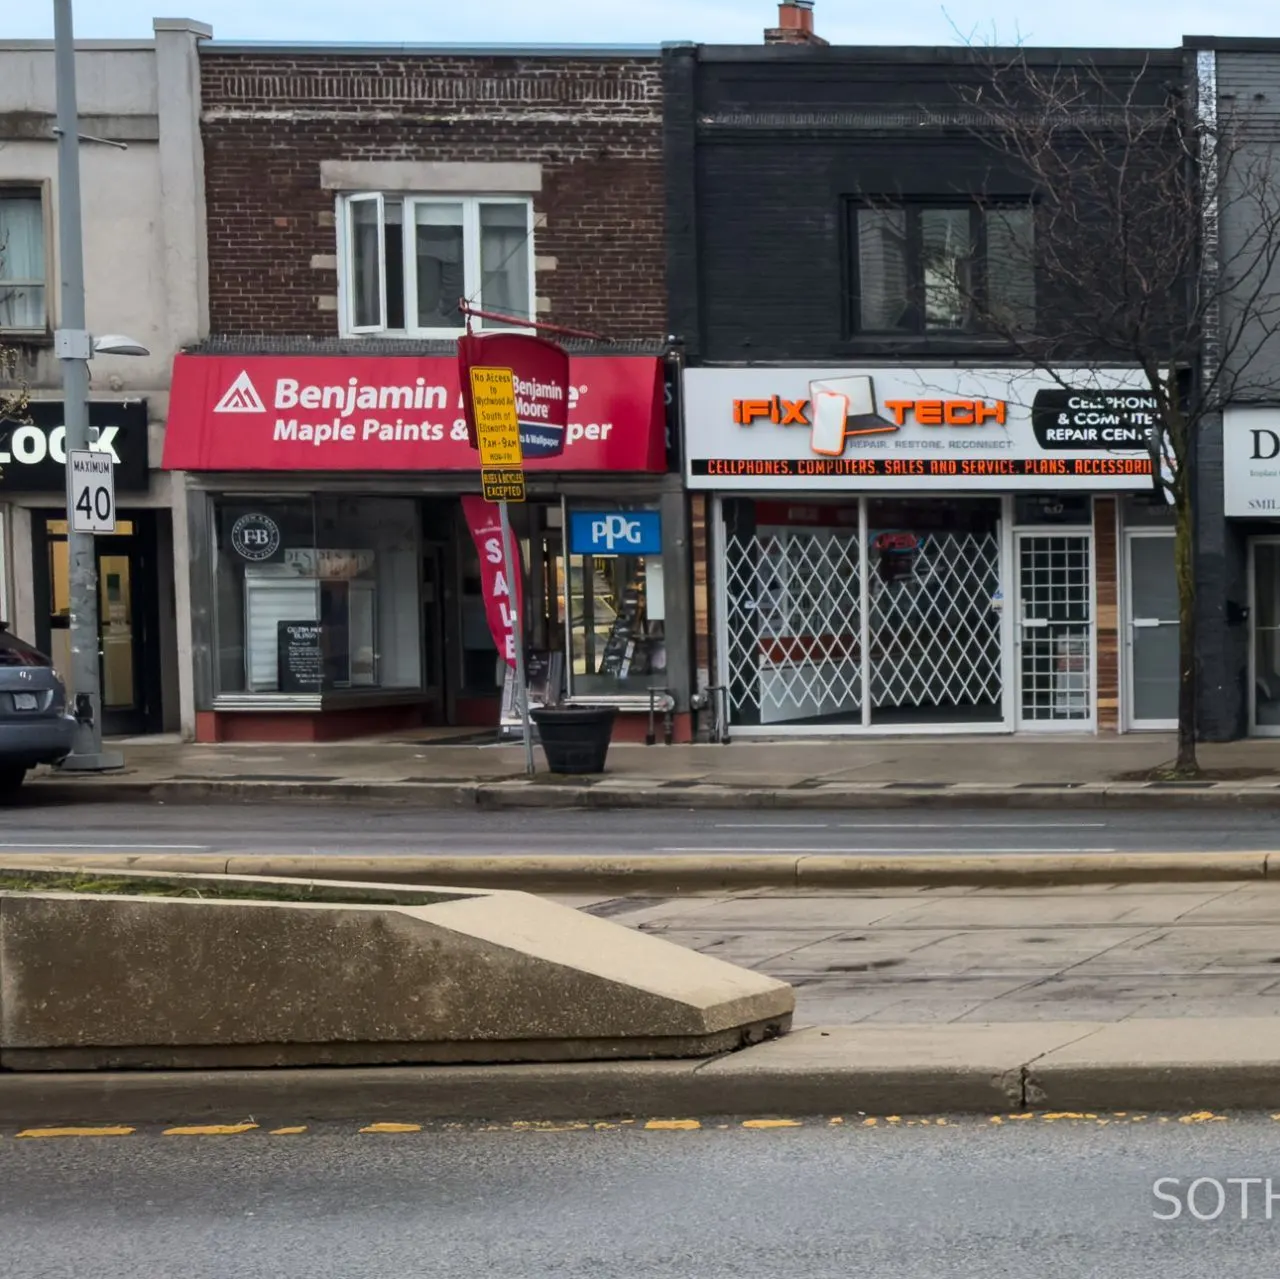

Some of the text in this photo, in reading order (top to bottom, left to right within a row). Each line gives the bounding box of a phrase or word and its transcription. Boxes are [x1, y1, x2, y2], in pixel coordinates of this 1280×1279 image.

[474, 373, 511, 382] No Access
[490, 386, 498, 394] to
[512, 375, 563, 401] Benjamin
[274, 377, 448, 417] Benjamin
[1068, 397, 1158, 410] CELLPHON
[515, 396, 549, 418] Moore
[884, 400, 1007, 425] TECH
[482, 411, 501, 420] South
[1057, 412, 1070, 425] &
[273, 419, 468, 446] Maple Paints &
[1046, 428, 1098, 440] REPAIR
[74, 460, 110, 473] MAXIMUM
[707, 459, 793, 475] CELLPHONES.
[798, 459, 879, 475] COMPUTERS.
[884, 459, 924, 475] SALES
[930, 459, 957, 475] AND
[961, 459, 1020, 475] SERVICE.
[1024, 459, 1070, 475] PLANS.
[487, 485, 522, 497] EXCEPTED
[76, 485, 111, 521] 40
[592, 515, 641, 550] PPG
[484, 537, 517, 661] SALE
